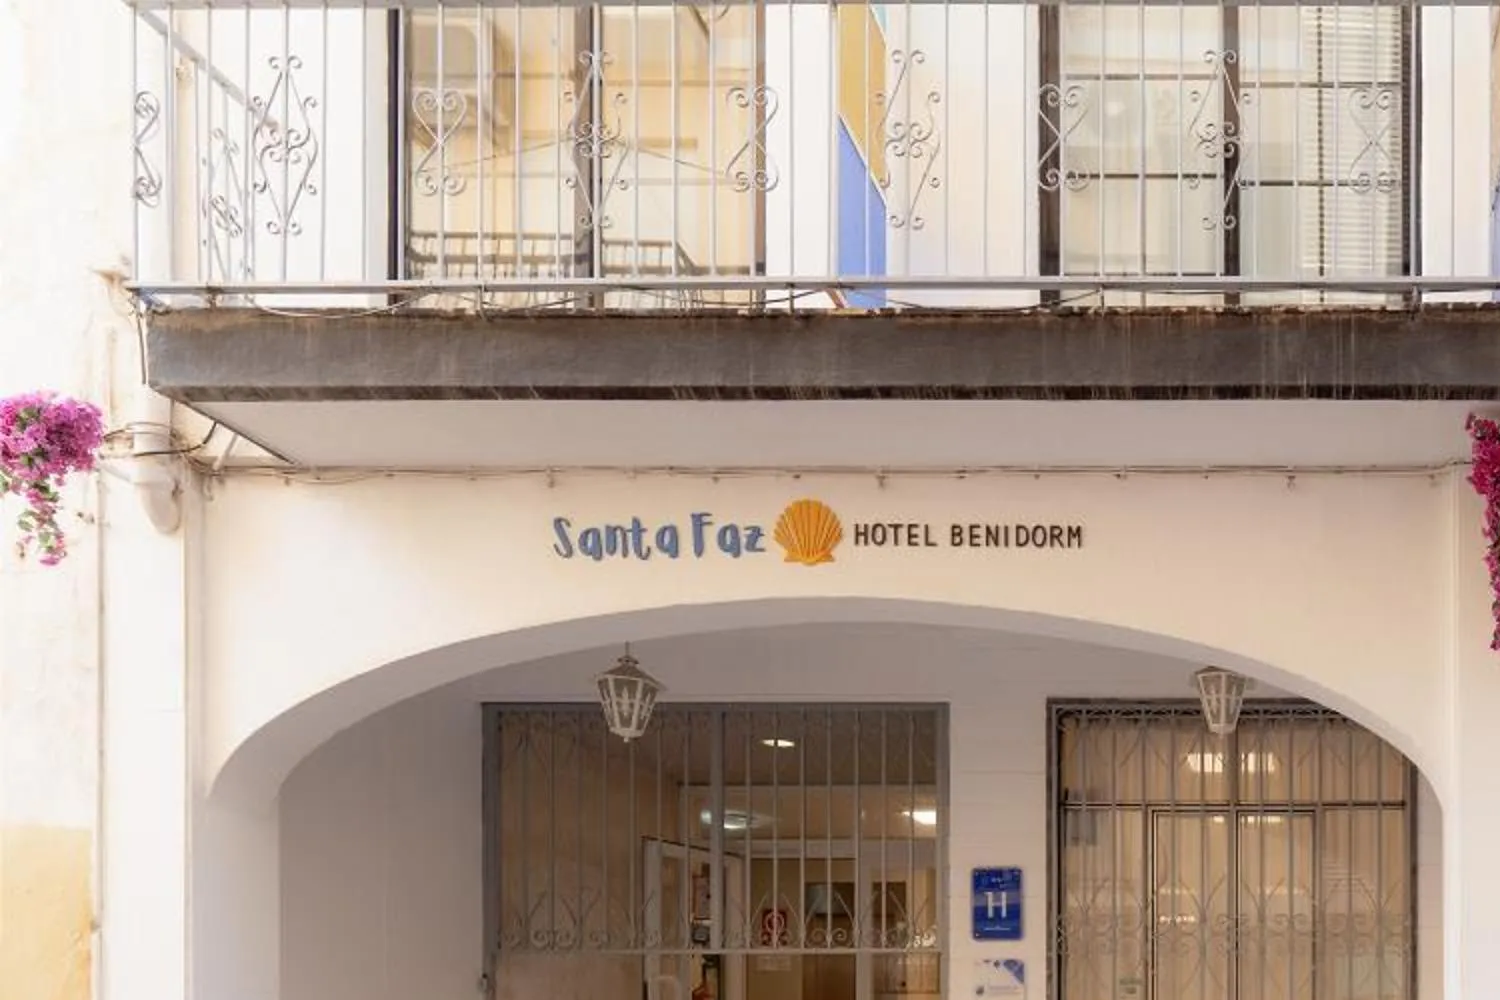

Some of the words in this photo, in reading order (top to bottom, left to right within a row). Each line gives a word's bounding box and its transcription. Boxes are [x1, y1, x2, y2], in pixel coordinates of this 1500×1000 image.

[552, 512, 679, 561] Santa
[690, 512, 767, 558] Faz
[853, 523, 937, 547] HOTEL
[950, 524, 1082, 548] BENIDORM
[984, 891, 1007, 919] H
